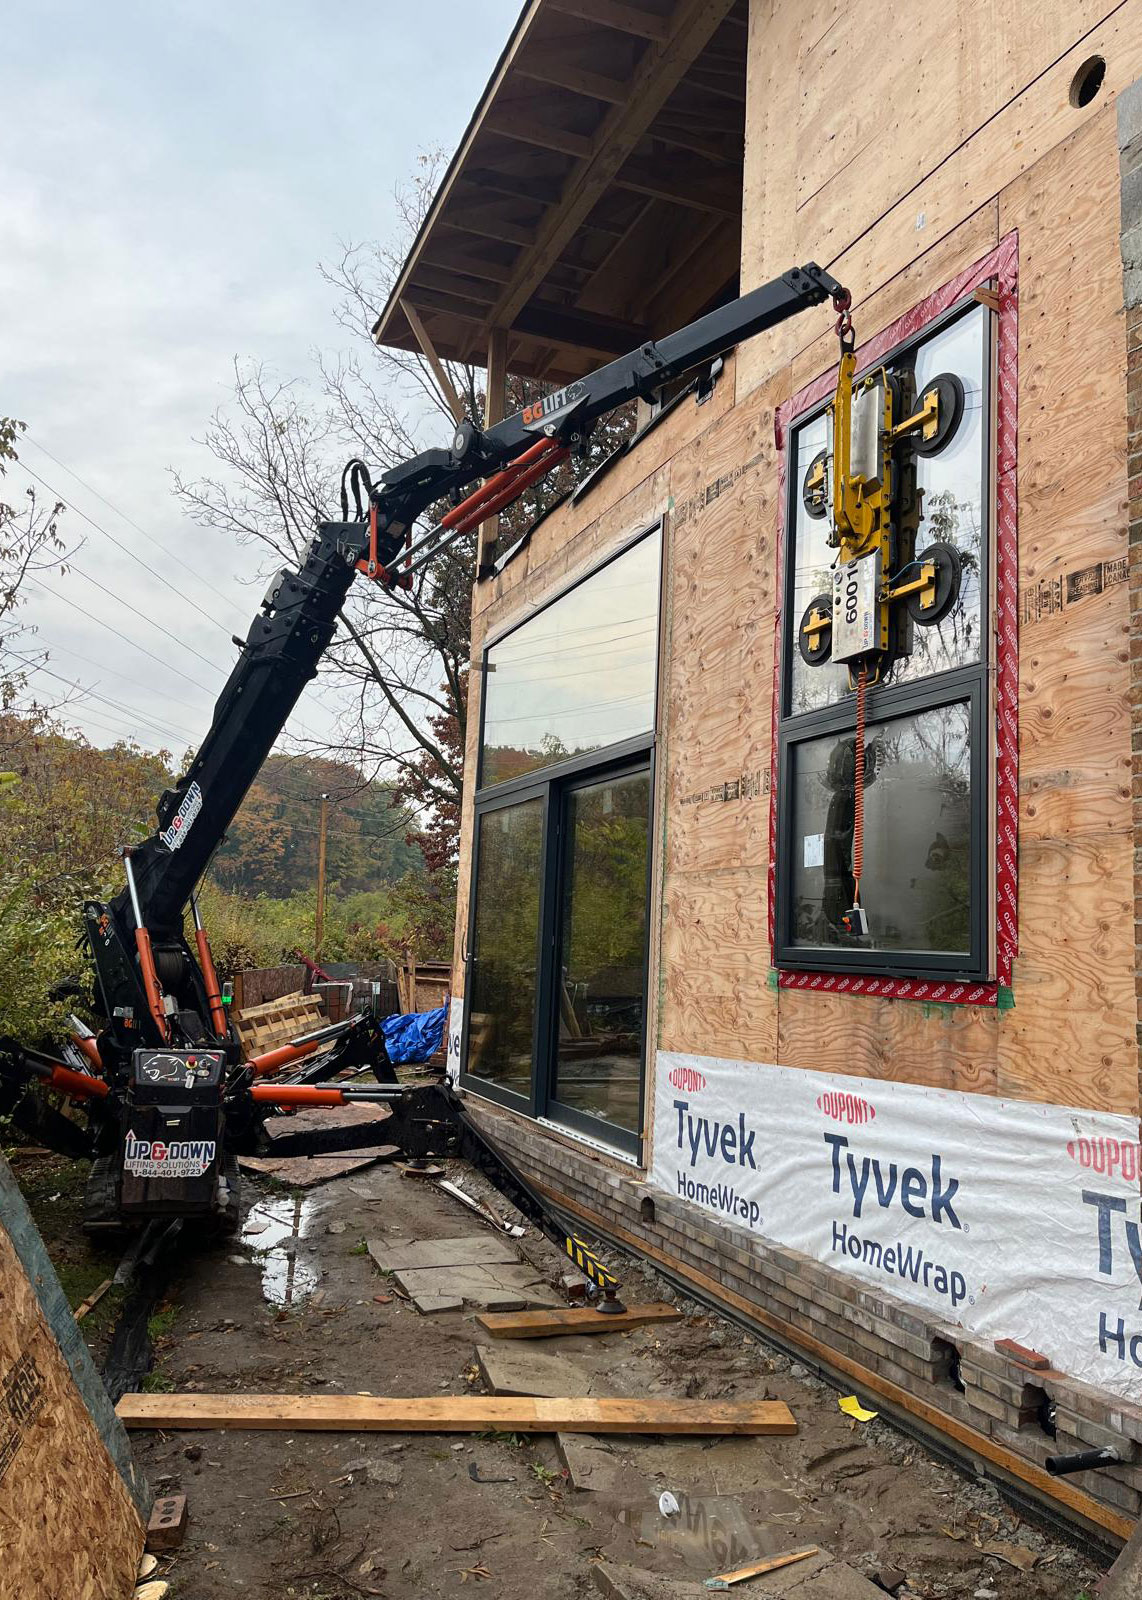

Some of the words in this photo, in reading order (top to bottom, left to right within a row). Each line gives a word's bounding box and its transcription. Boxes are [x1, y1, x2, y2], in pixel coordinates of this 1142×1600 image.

[672, 1068, 702, 1092] DUPONT
[823, 1092, 868, 1124] DUPONT
[126, 1138, 148, 1160] UP
[152, 1143, 168, 1160] &
[169, 1142, 215, 1161] DOWN
[673, 1099, 757, 1170] Tyvek
[125, 1160, 154, 1169] LIFTING
[156, 1160, 200, 1169] SOLUTIONS
[134, 1168, 201, 1177] 1-844-401-9723
[1077, 1137, 1142, 1181] DUPO
[677, 1170, 760, 1227] HomeWrap
[823, 1132, 962, 1229] Tyvek
[832, 1220, 967, 1307] HomeWrap
